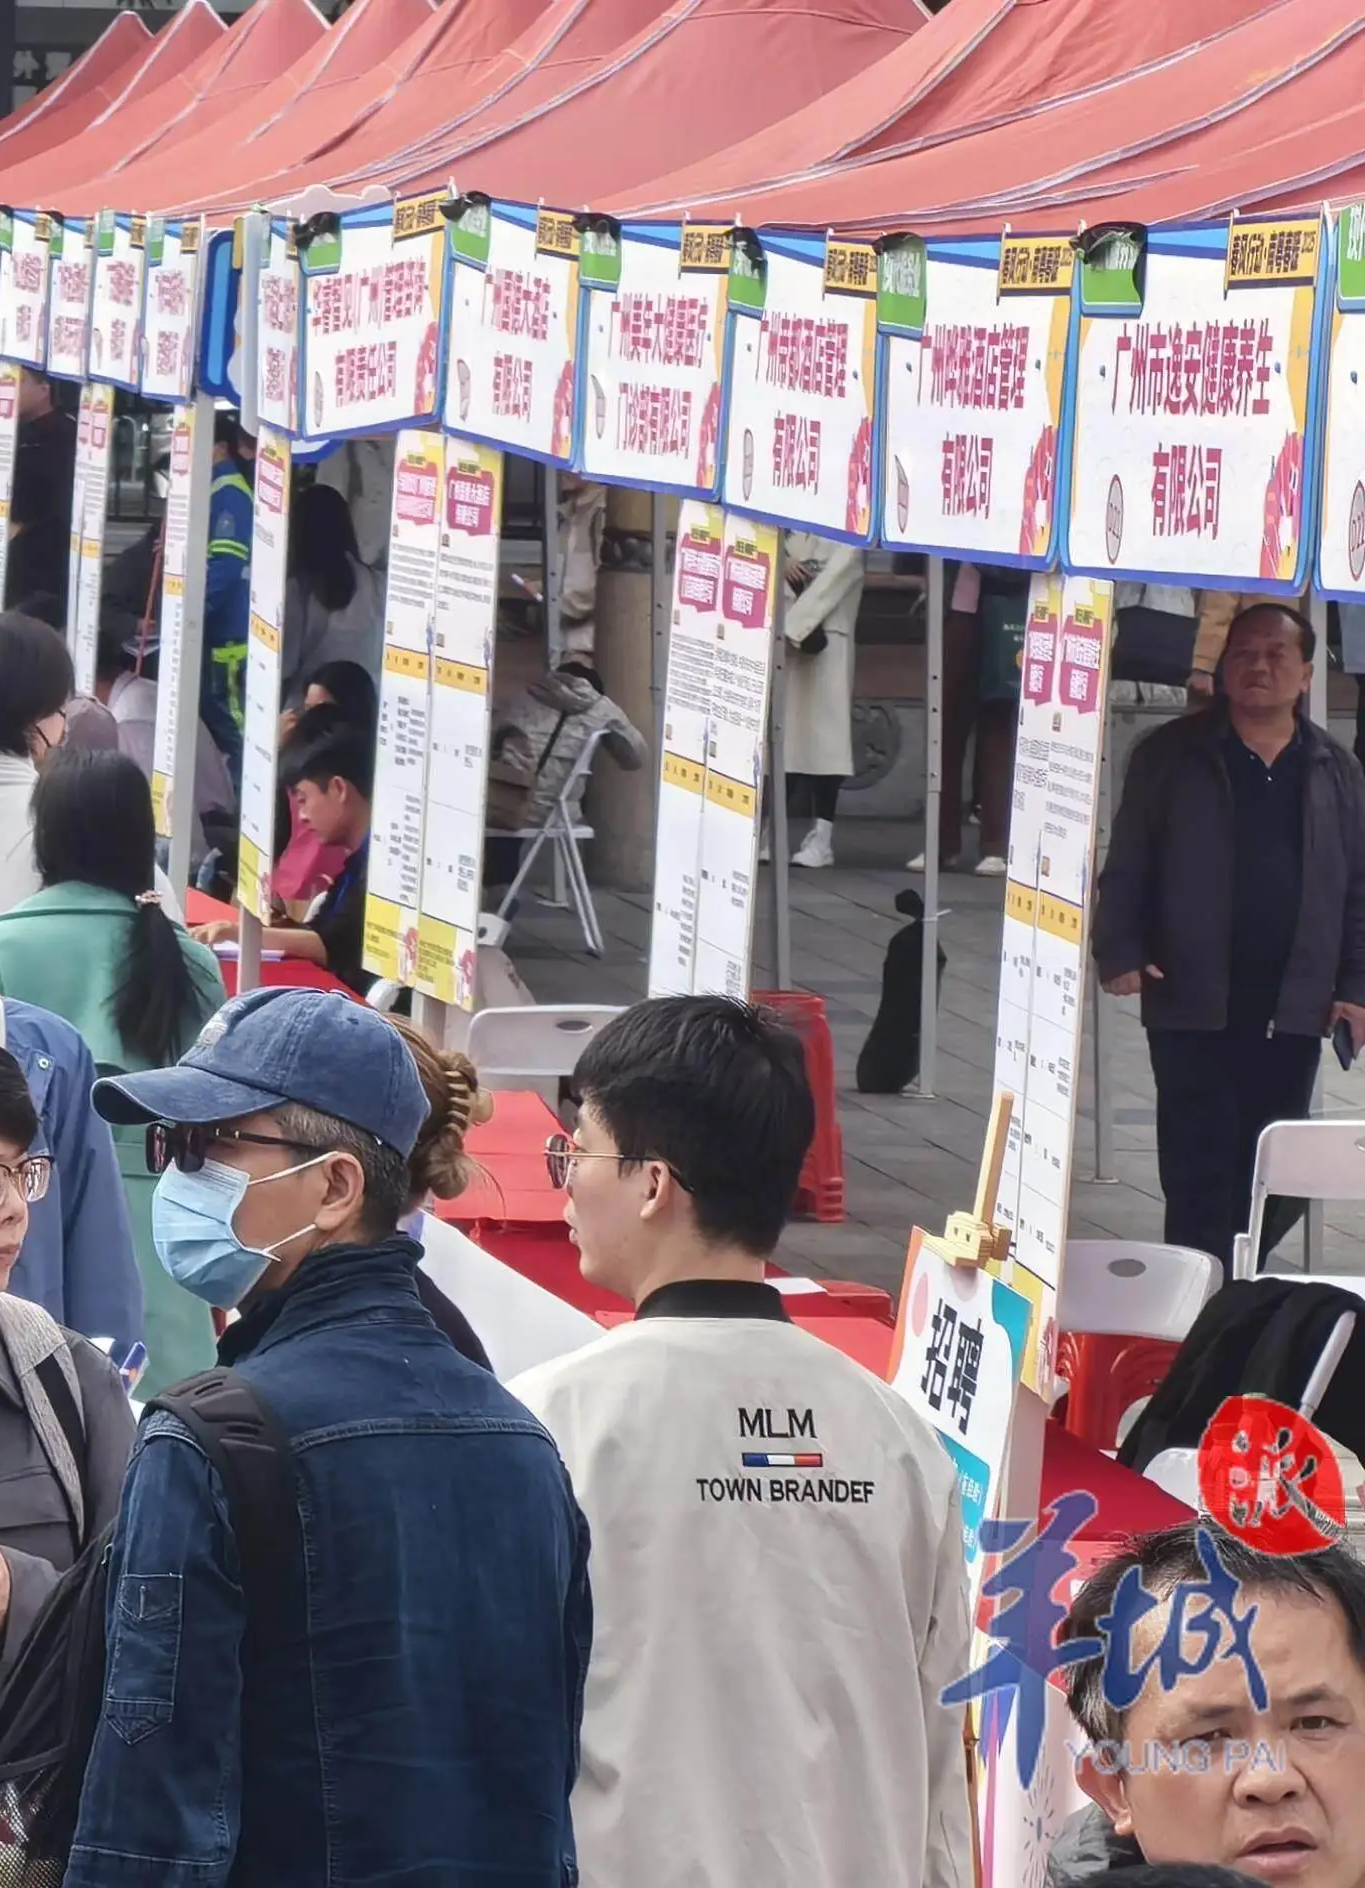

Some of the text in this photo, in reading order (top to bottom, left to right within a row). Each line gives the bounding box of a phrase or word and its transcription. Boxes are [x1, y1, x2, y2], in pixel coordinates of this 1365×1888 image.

[1111, 316, 1274, 419] 广州市逸安健康养生
[771, 409, 822, 496] 有限公司
[941, 429, 994, 520] 有限公司
[1151, 441, 1223, 542] 有限公司
[919, 1296, 987, 1437] 招聘
[737, 1406, 818, 1440] MLM
[695, 1477, 877, 1506] TOWN BRANDEF
